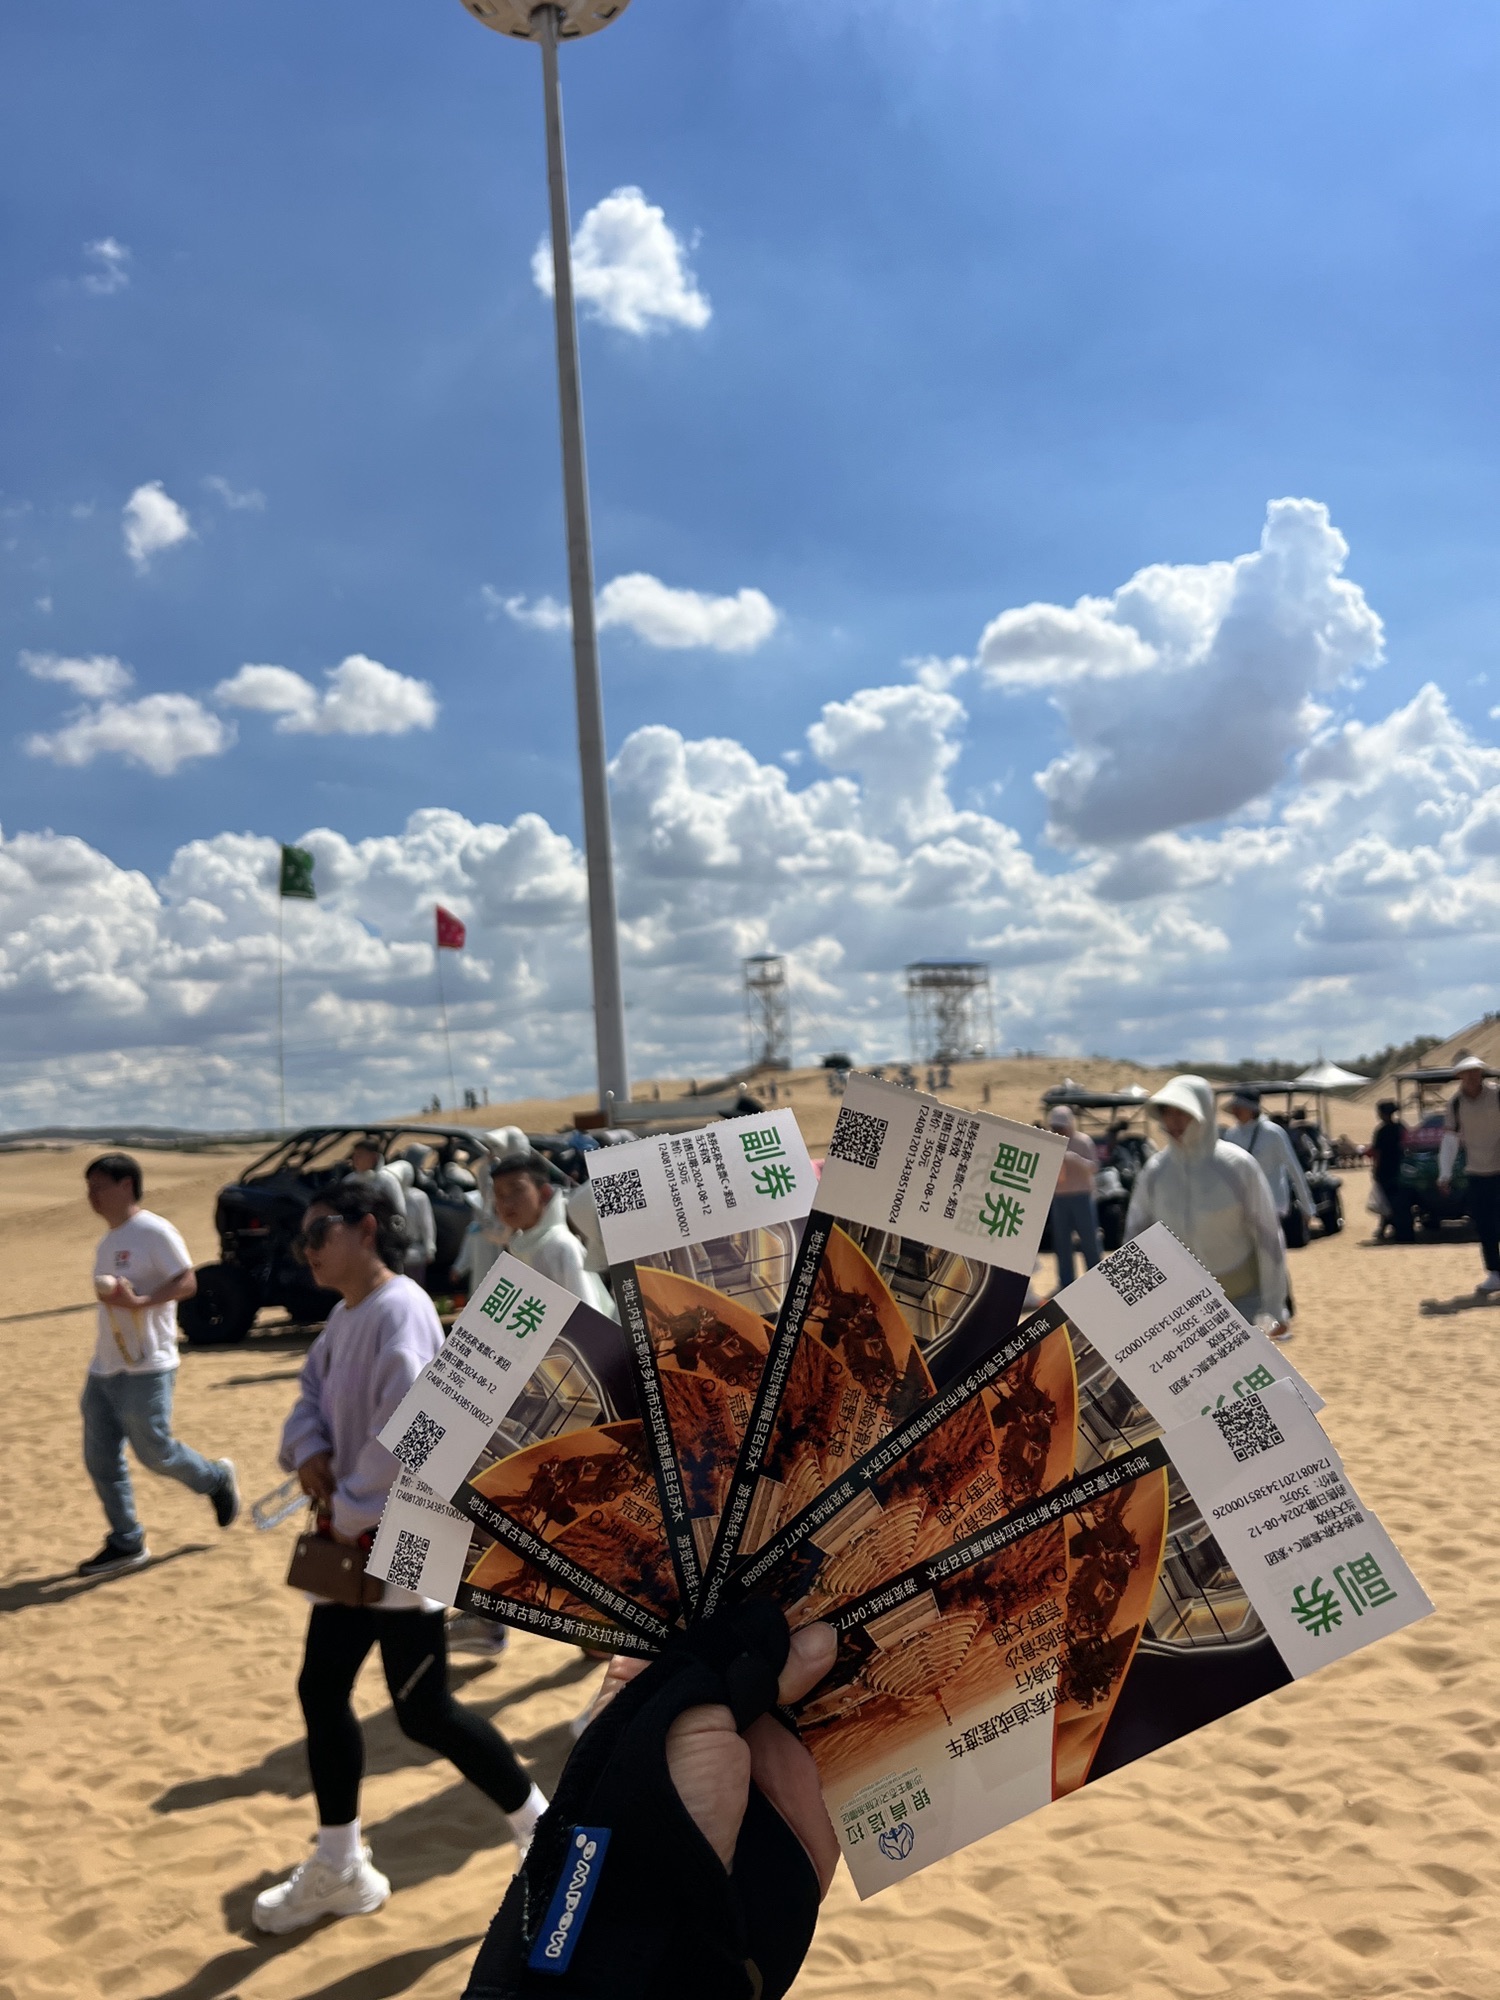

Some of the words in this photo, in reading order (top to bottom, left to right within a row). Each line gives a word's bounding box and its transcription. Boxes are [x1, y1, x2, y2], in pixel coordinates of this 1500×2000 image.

[694, 1133, 711, 1165] 当天有效
[741, 1127, 793, 1200] 副券
[948, 1115, 968, 1158] 当天有效
[980, 1144, 1038, 1236] 副券
[481, 1280, 544, 1338] 副券
[1205, 1318, 1242, 1350] 当天有效
[447, 1335, 472, 1358] 当天有效
[742, 1229, 826, 1472] 地址:内蒙古鄂尔多斯市达拉特旗展旦召苏木
[619, 1277, 686, 1523] 地址:内蒙古鄂尔多斯市达拉特旗展旦召苏木
[856, 1315, 1051, 1482] 地址:内蒙古鄂尔多斯市达拉特旗展旦召苏木
[924, 1453, 1150, 1581] 地址:内蒙古鄂尔多斯市达拉特旗展旦召苏木
[933, 1469, 999, 1527] 荒野大炮
[1312, 1497, 1357, 1526] 当天有效
[465, 1493, 672, 1641] 地址:内蒙古鄂尔多斯市达拉特旗展旦召苏木
[1292, 1554, 1393, 1635] 副券
[990, 1597, 1064, 1647] 荒野大炮
[1000, 1620, 1075, 1671] 惊险滑沙
